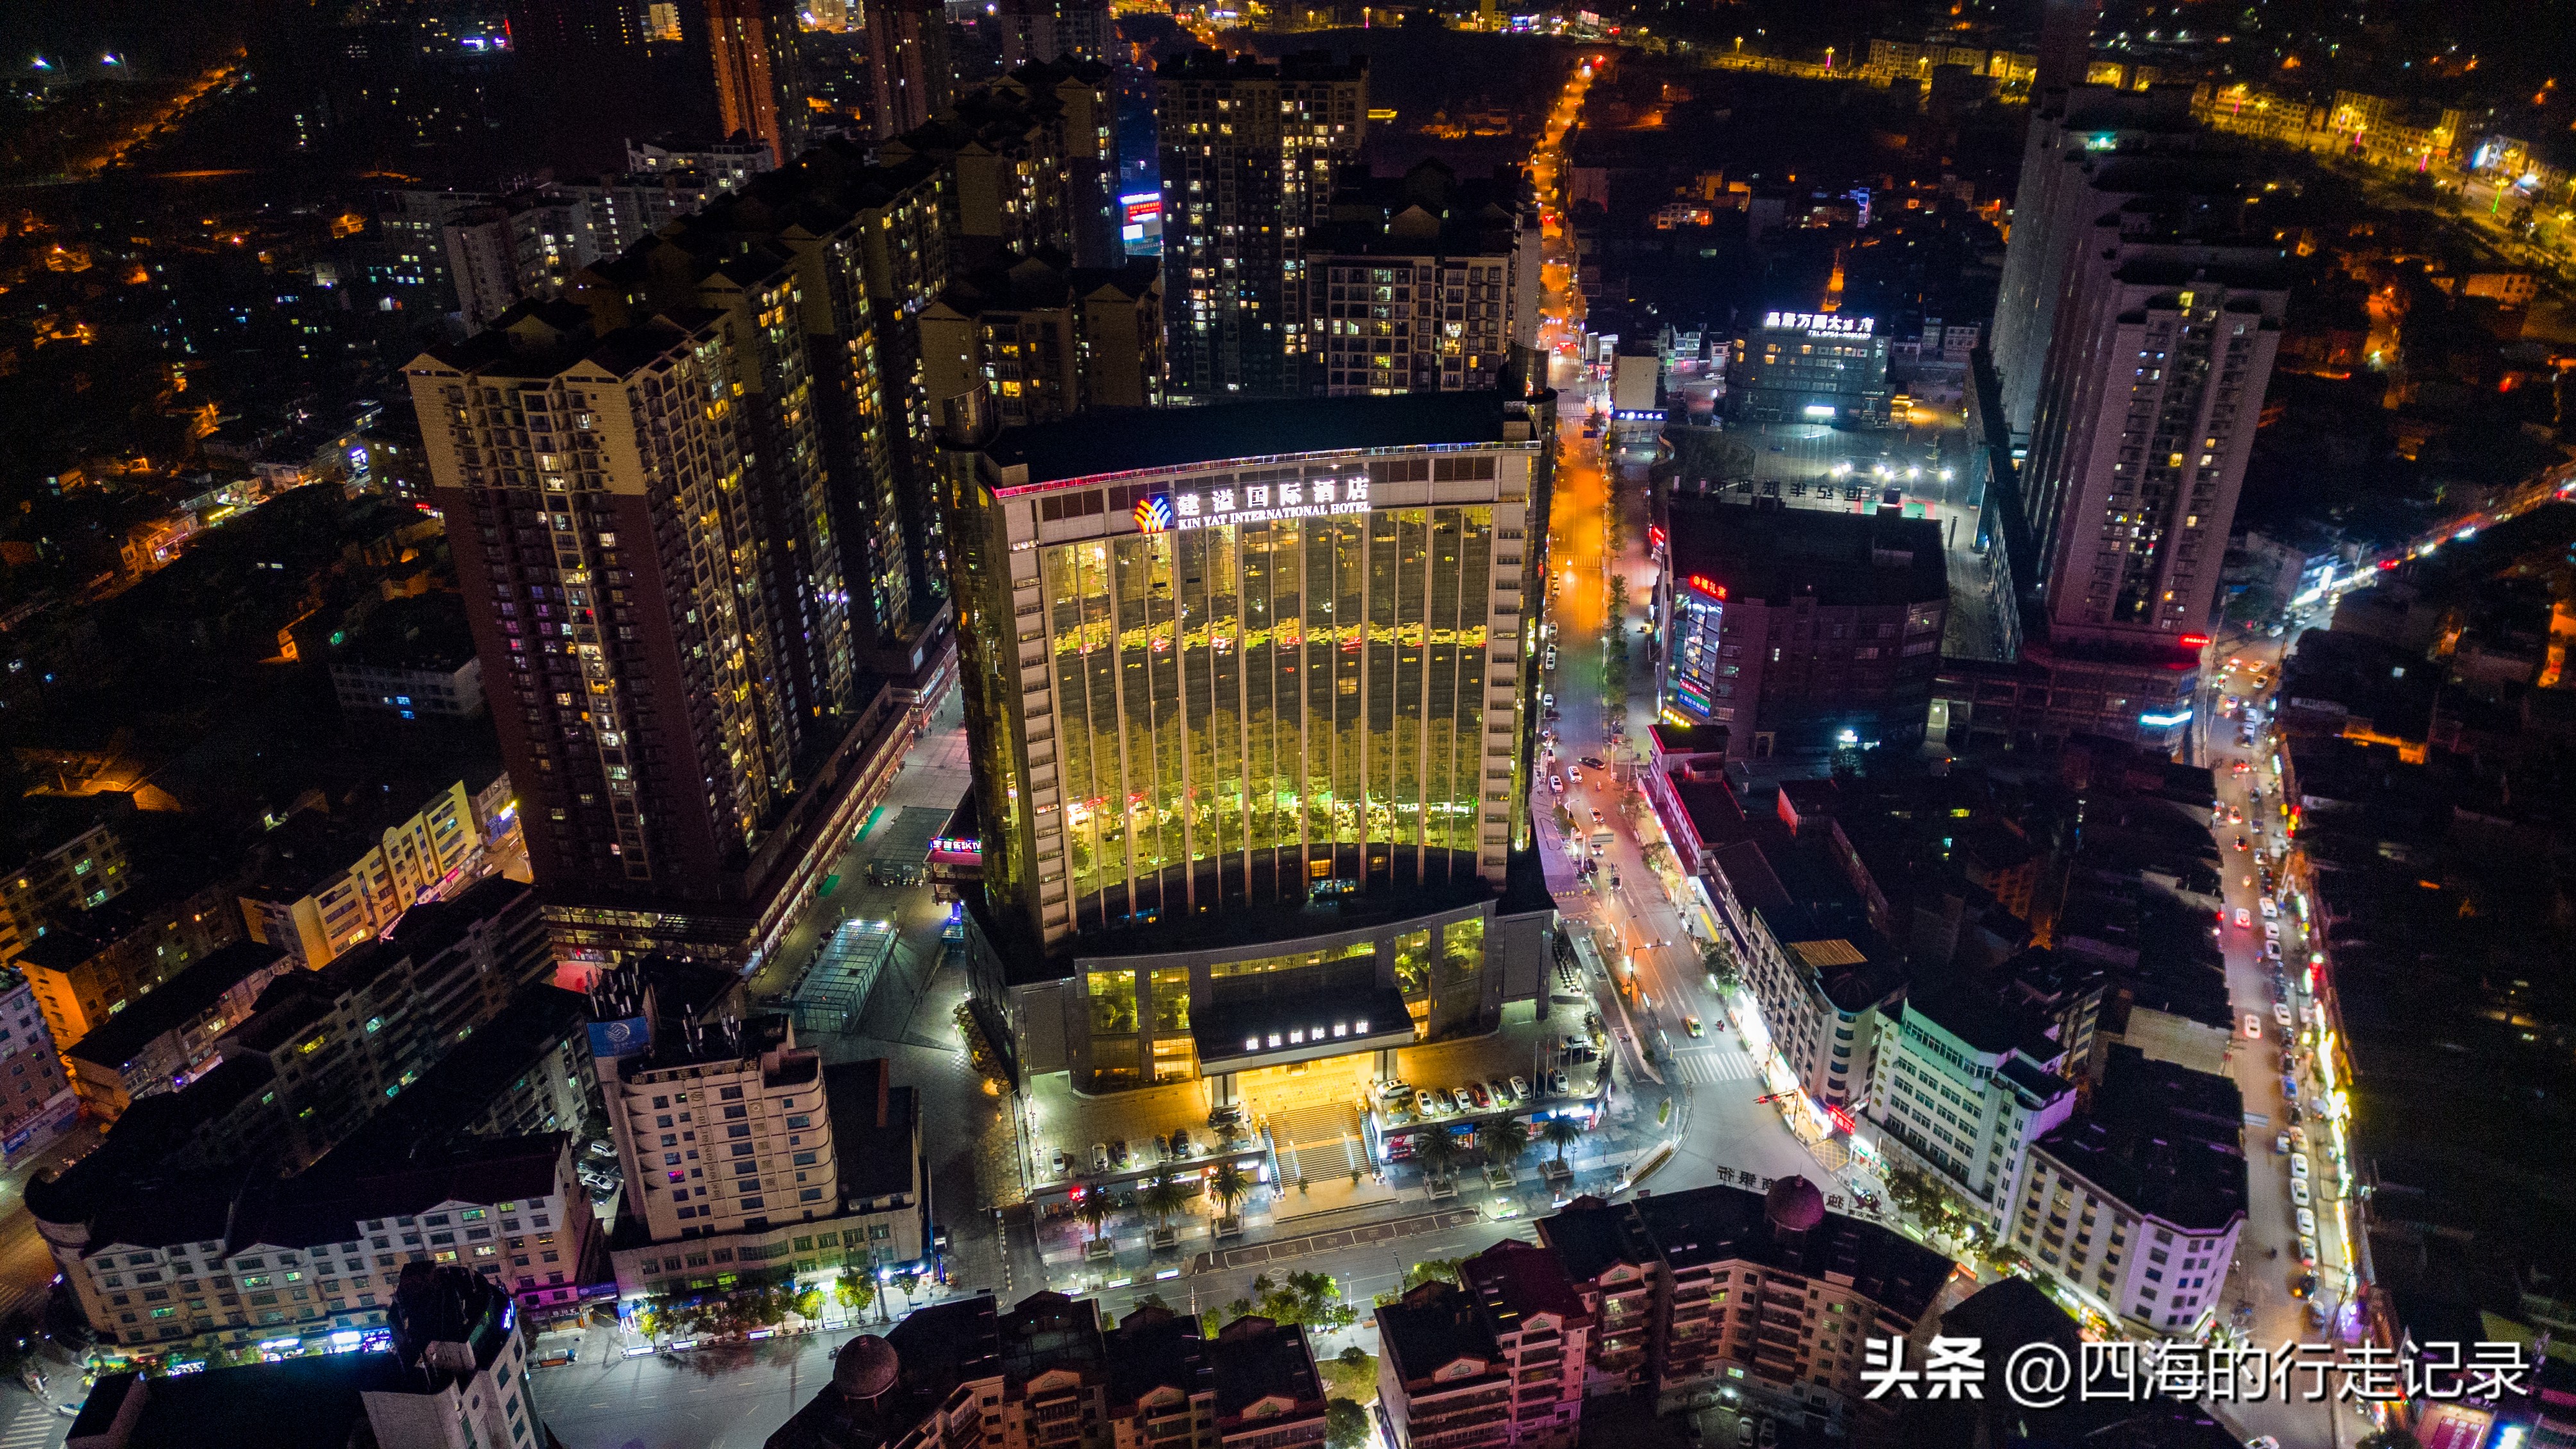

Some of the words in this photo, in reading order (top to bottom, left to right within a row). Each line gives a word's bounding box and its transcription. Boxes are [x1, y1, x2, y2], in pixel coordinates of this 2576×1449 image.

[1177, 477, 1369, 516] 建溢国际酒店
[1178, 518, 1201, 530] KIN
[1203, 514, 1228, 527] YAT
[1230, 504, 1328, 524] INTERNATIONAL
[1330, 501, 1371, 516] HOTEL
